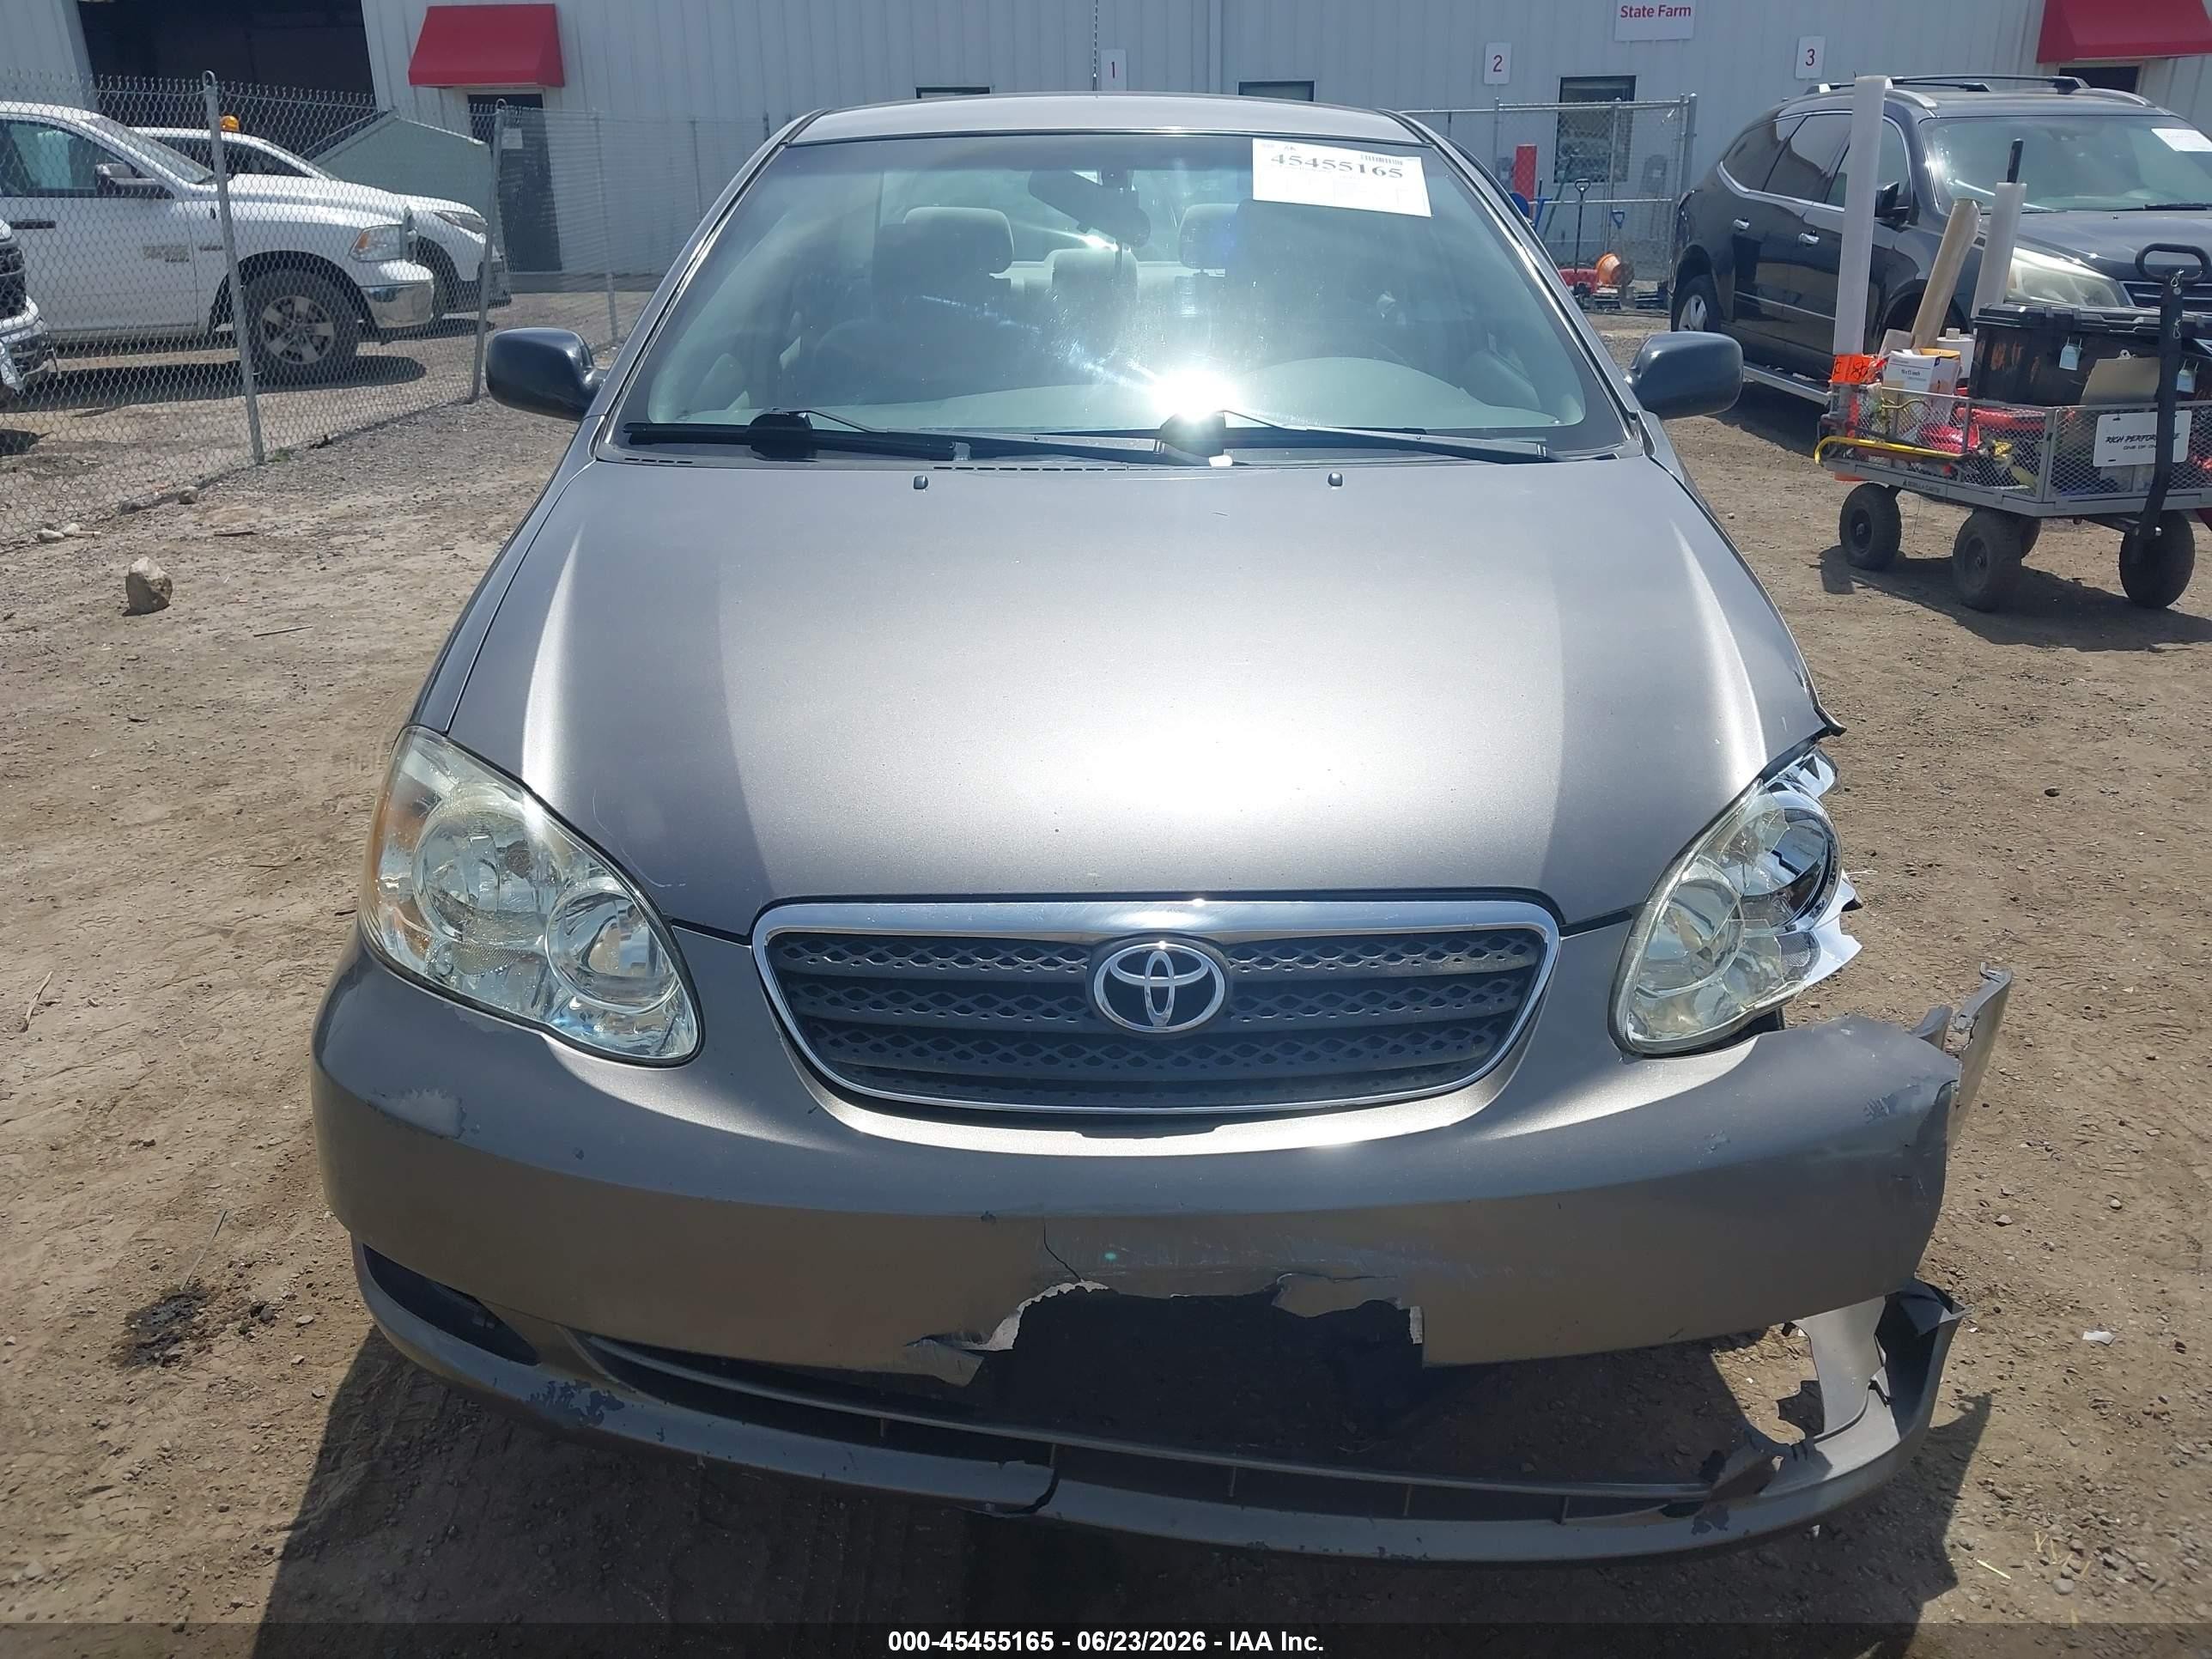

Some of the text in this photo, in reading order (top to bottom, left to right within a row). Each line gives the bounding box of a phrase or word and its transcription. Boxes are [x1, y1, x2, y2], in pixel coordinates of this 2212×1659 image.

[1620, 4, 1692, 18] State Farm
[1492, 54, 1503, 72] 2
[1805, 48, 1815, 66] 3
[1110, 61, 1115, 78] 1
[1271, 153, 1404, 179] 45455165
